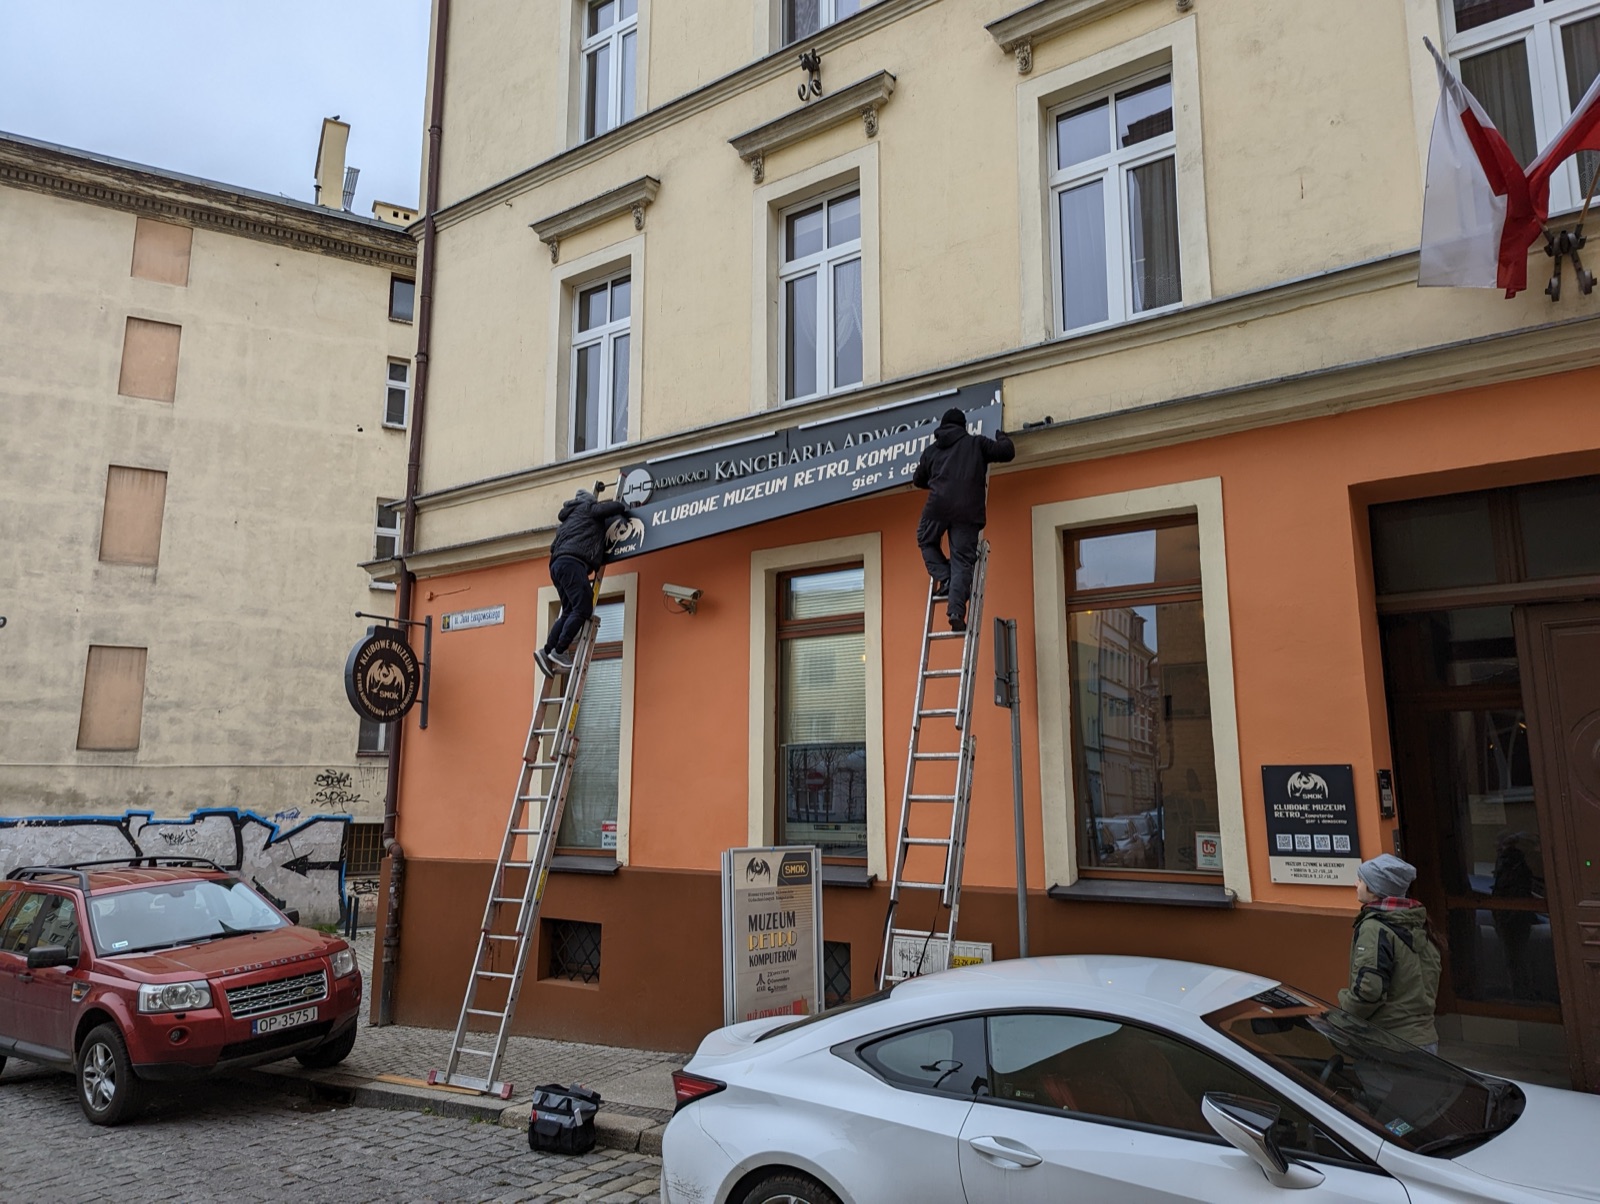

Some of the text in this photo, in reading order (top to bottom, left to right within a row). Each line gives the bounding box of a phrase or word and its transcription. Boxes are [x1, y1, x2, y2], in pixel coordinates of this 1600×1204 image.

[653, 469, 709, 489] ADWOKACI
[714, 440, 836, 481] KANCELARIA
[851, 472, 882, 491] gier
[888, 467, 894, 479] i
[652, 495, 719, 526] KLUBOWE
[723, 476, 788, 507] MUZEUM
[613, 543, 637, 556] SMOK
[360, 640, 414, 673] KLUBOWE MUZEUM
[380, 690, 399, 700] SMOK
[785, 864, 806, 874] SMOK
[748, 910, 796, 932] MUZEUM
[748, 930, 797, 951] RETRO
[222, 952, 316, 975] LAND ROVER
[749, 946, 798, 967] KOMPUTERÓW
[259, 1008, 316, 1032] OP 3575J
